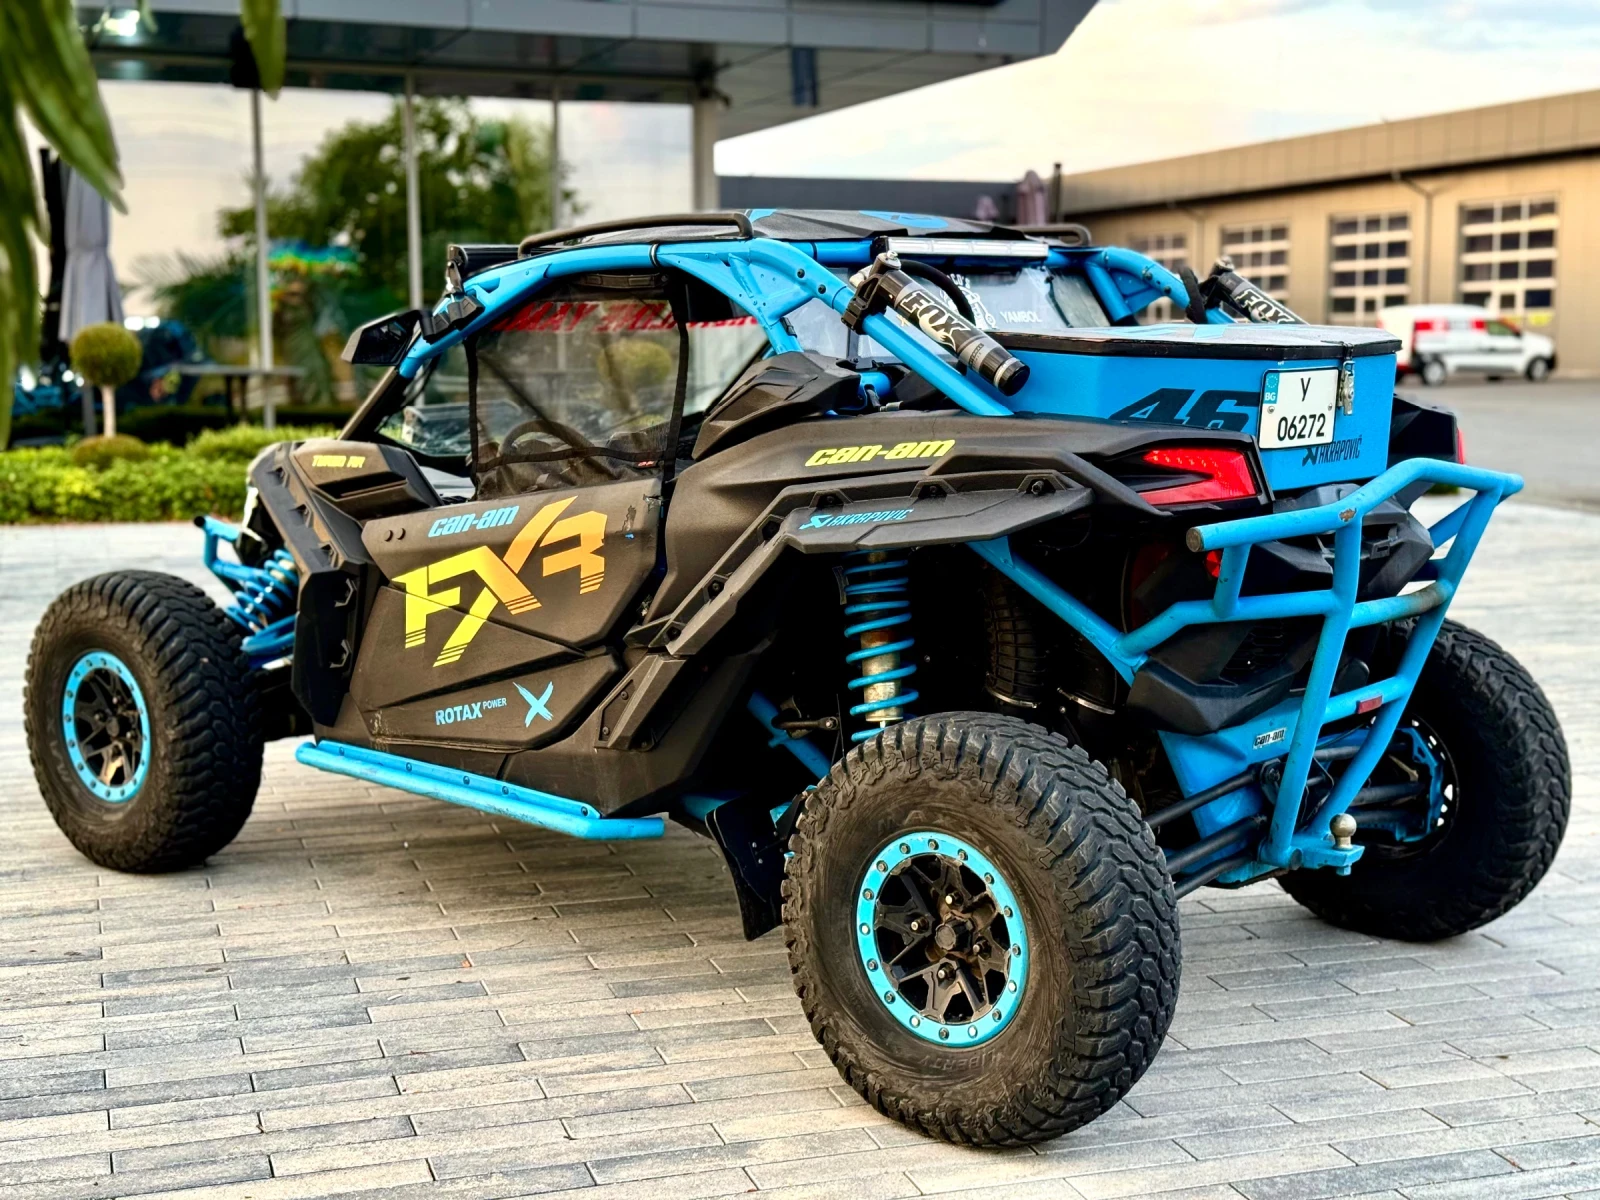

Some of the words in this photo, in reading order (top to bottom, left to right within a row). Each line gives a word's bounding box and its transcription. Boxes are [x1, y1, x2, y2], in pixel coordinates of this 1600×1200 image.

[900, 290, 970, 331] FOX
[1000, 311, 1042, 323] YAMBOL
[1234, 288, 1296, 324] FOX
[1264, 392, 1276, 401] BG
[1300, 377, 1311, 402] Y
[1108, 387, 1260, 432] 46
[1277, 413, 1326, 441] 06272
[391, 495, 608, 668] FXR
[435, 701, 483, 726] ROTAX
[482, 697, 507, 710] POWER
